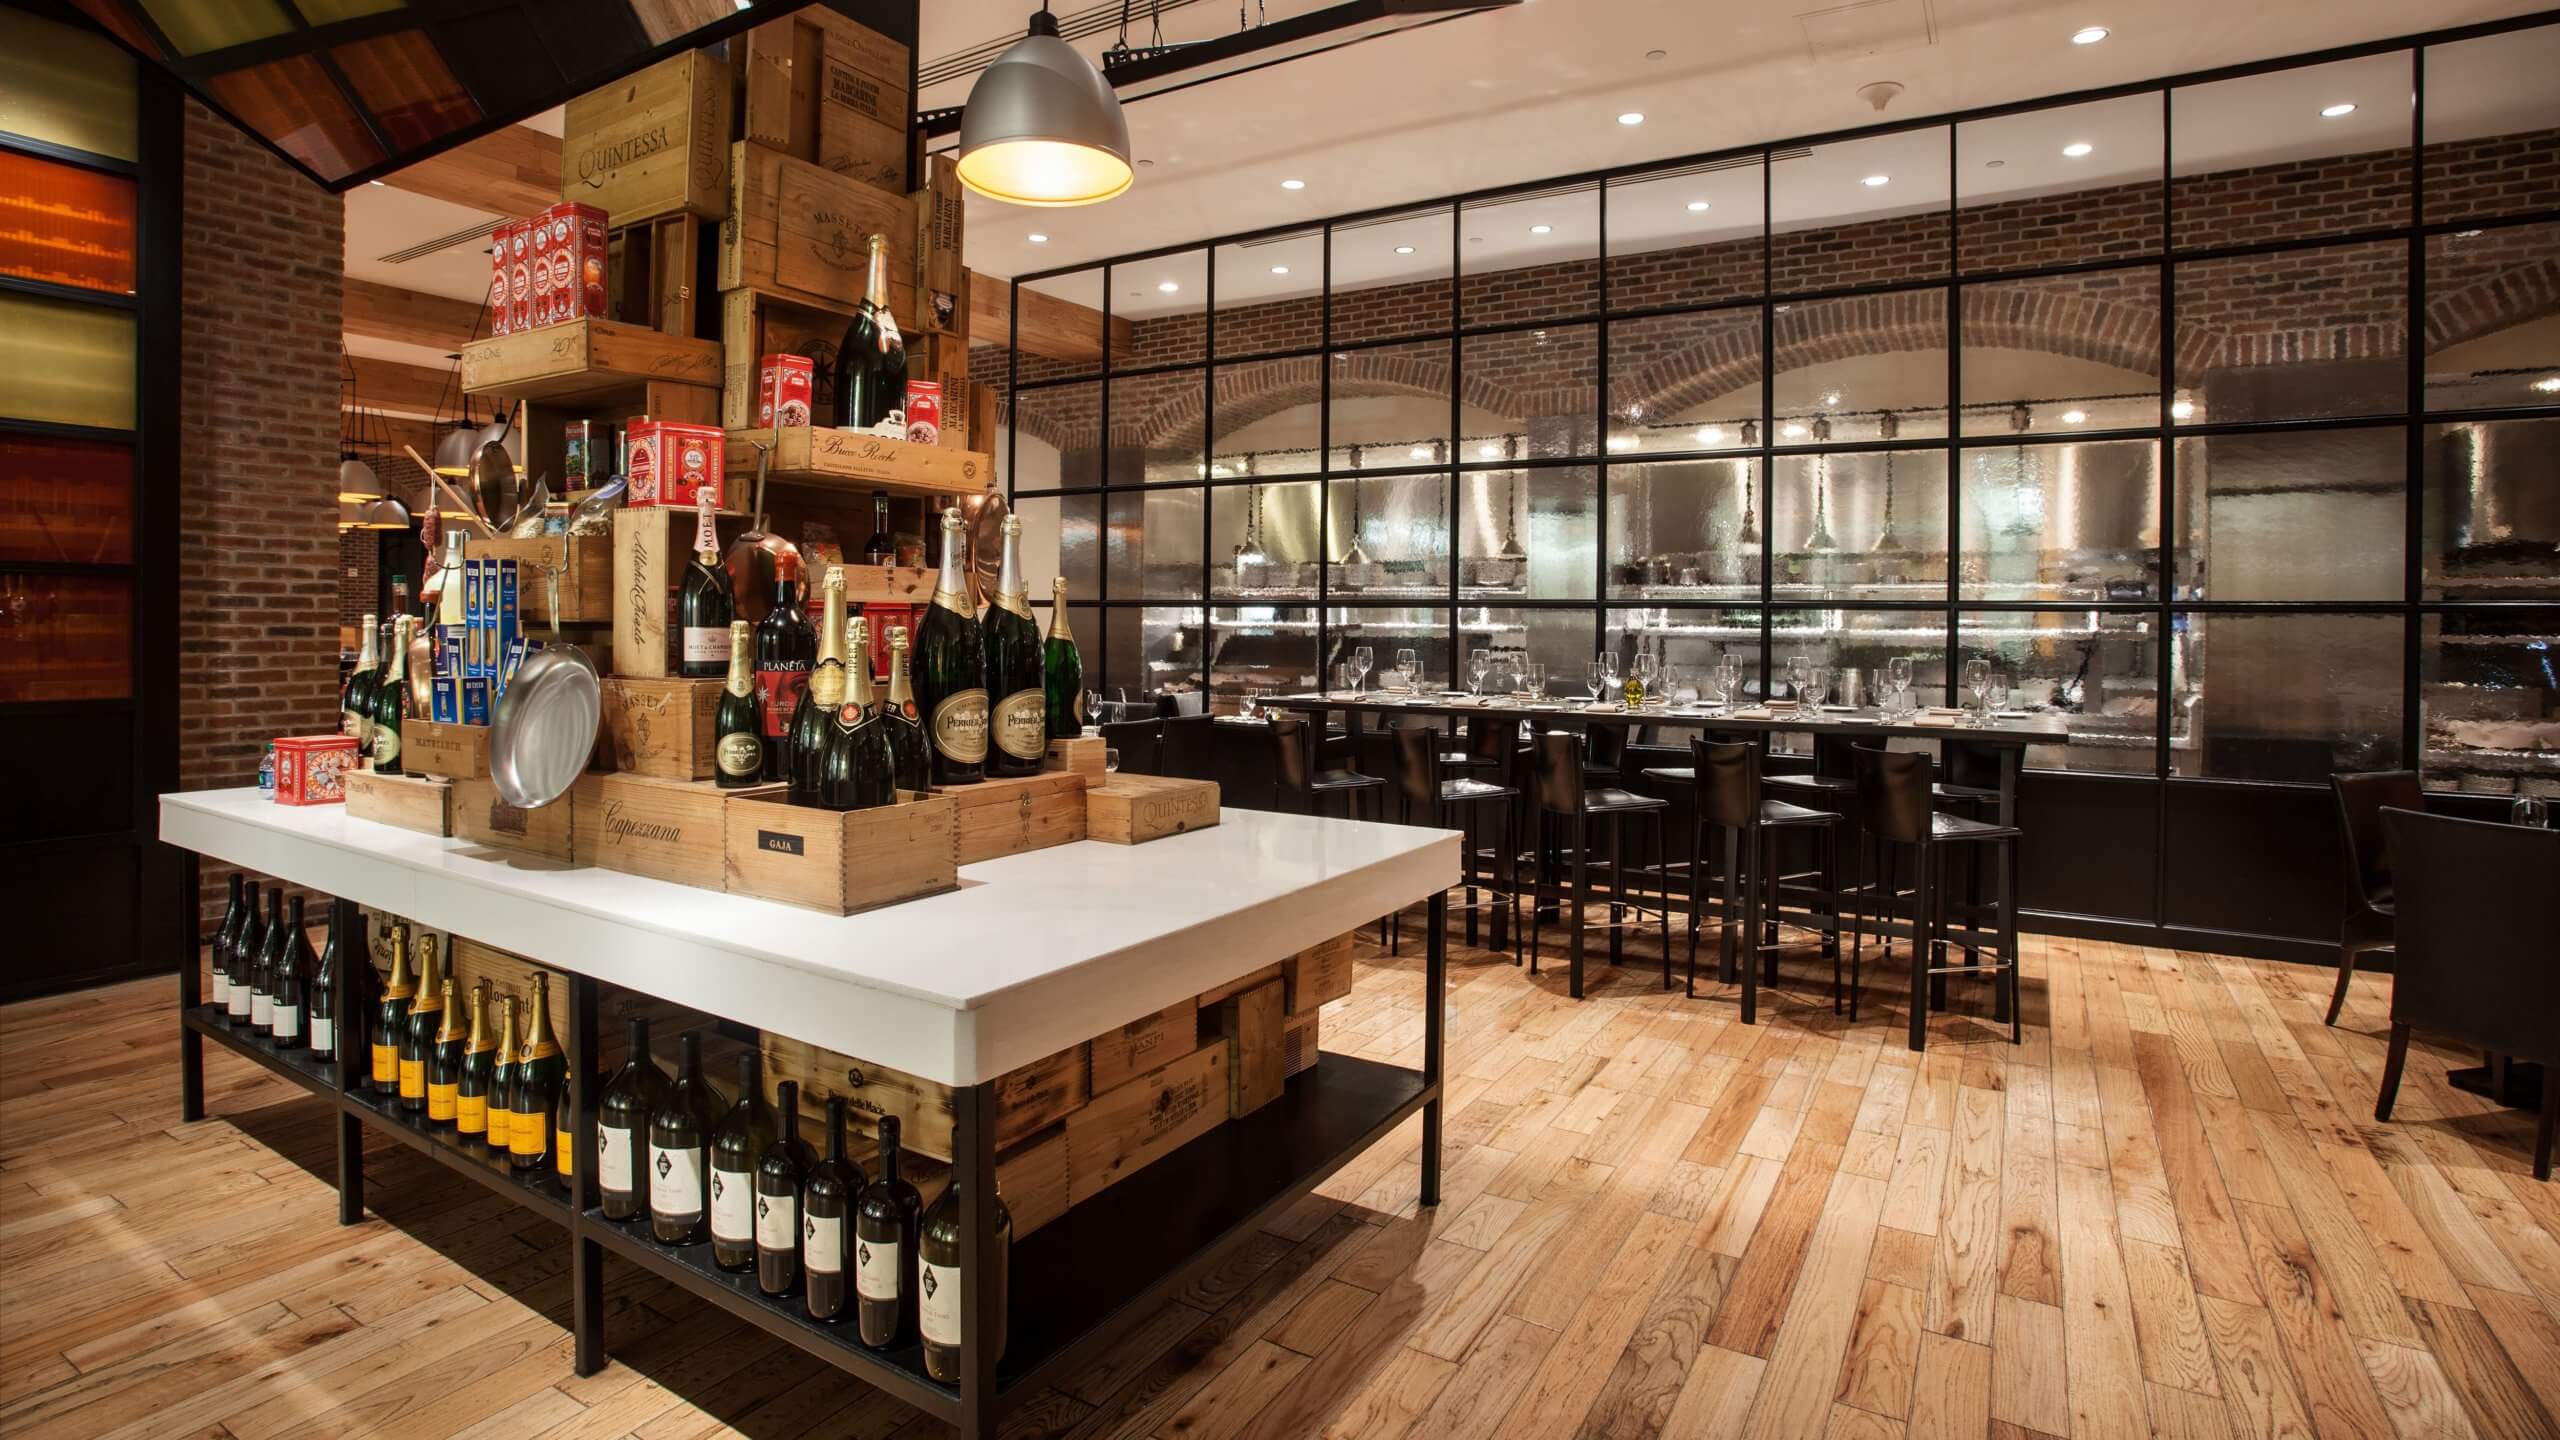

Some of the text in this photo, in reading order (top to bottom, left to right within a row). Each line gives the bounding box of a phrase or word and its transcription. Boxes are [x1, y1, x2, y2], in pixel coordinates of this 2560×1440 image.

[578, 127, 669, 189] QUINTESSA
[601, 799, 681, 845] Capezzana
[1143, 790, 1209, 831] QUINTESSA
[769, 839, 792, 852] GAJA
